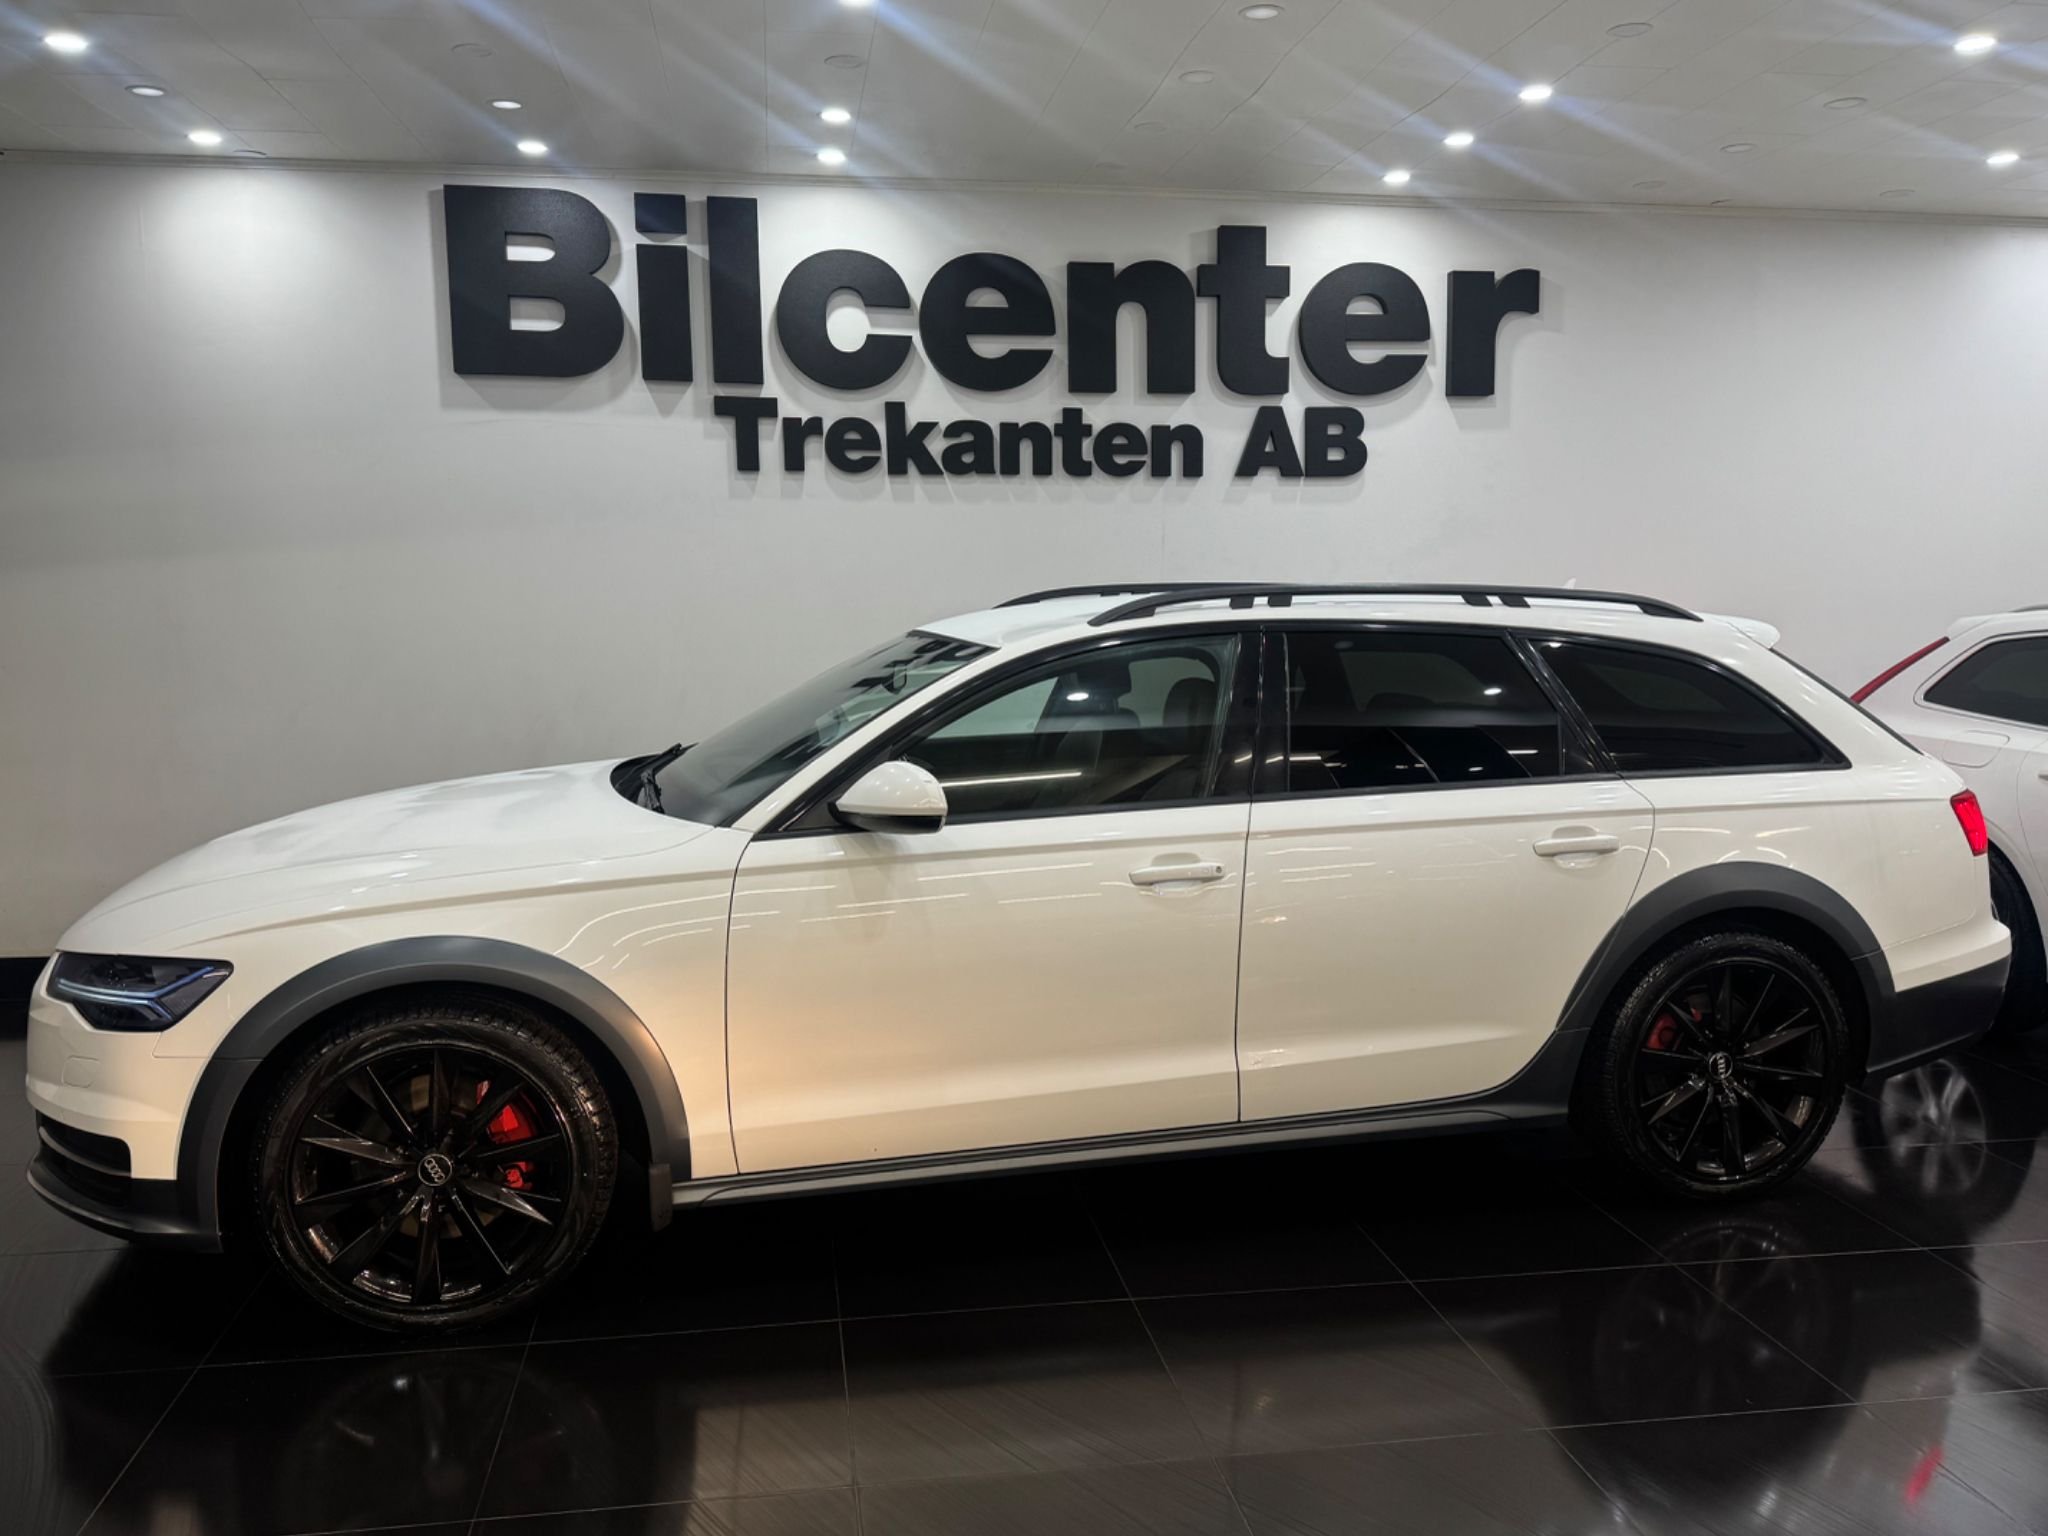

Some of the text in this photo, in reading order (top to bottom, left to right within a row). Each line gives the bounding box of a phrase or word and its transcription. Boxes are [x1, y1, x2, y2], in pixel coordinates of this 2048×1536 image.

[443, 184, 1541, 398] Bilcenter
[713, 396, 1368, 479] Trekanten AB
